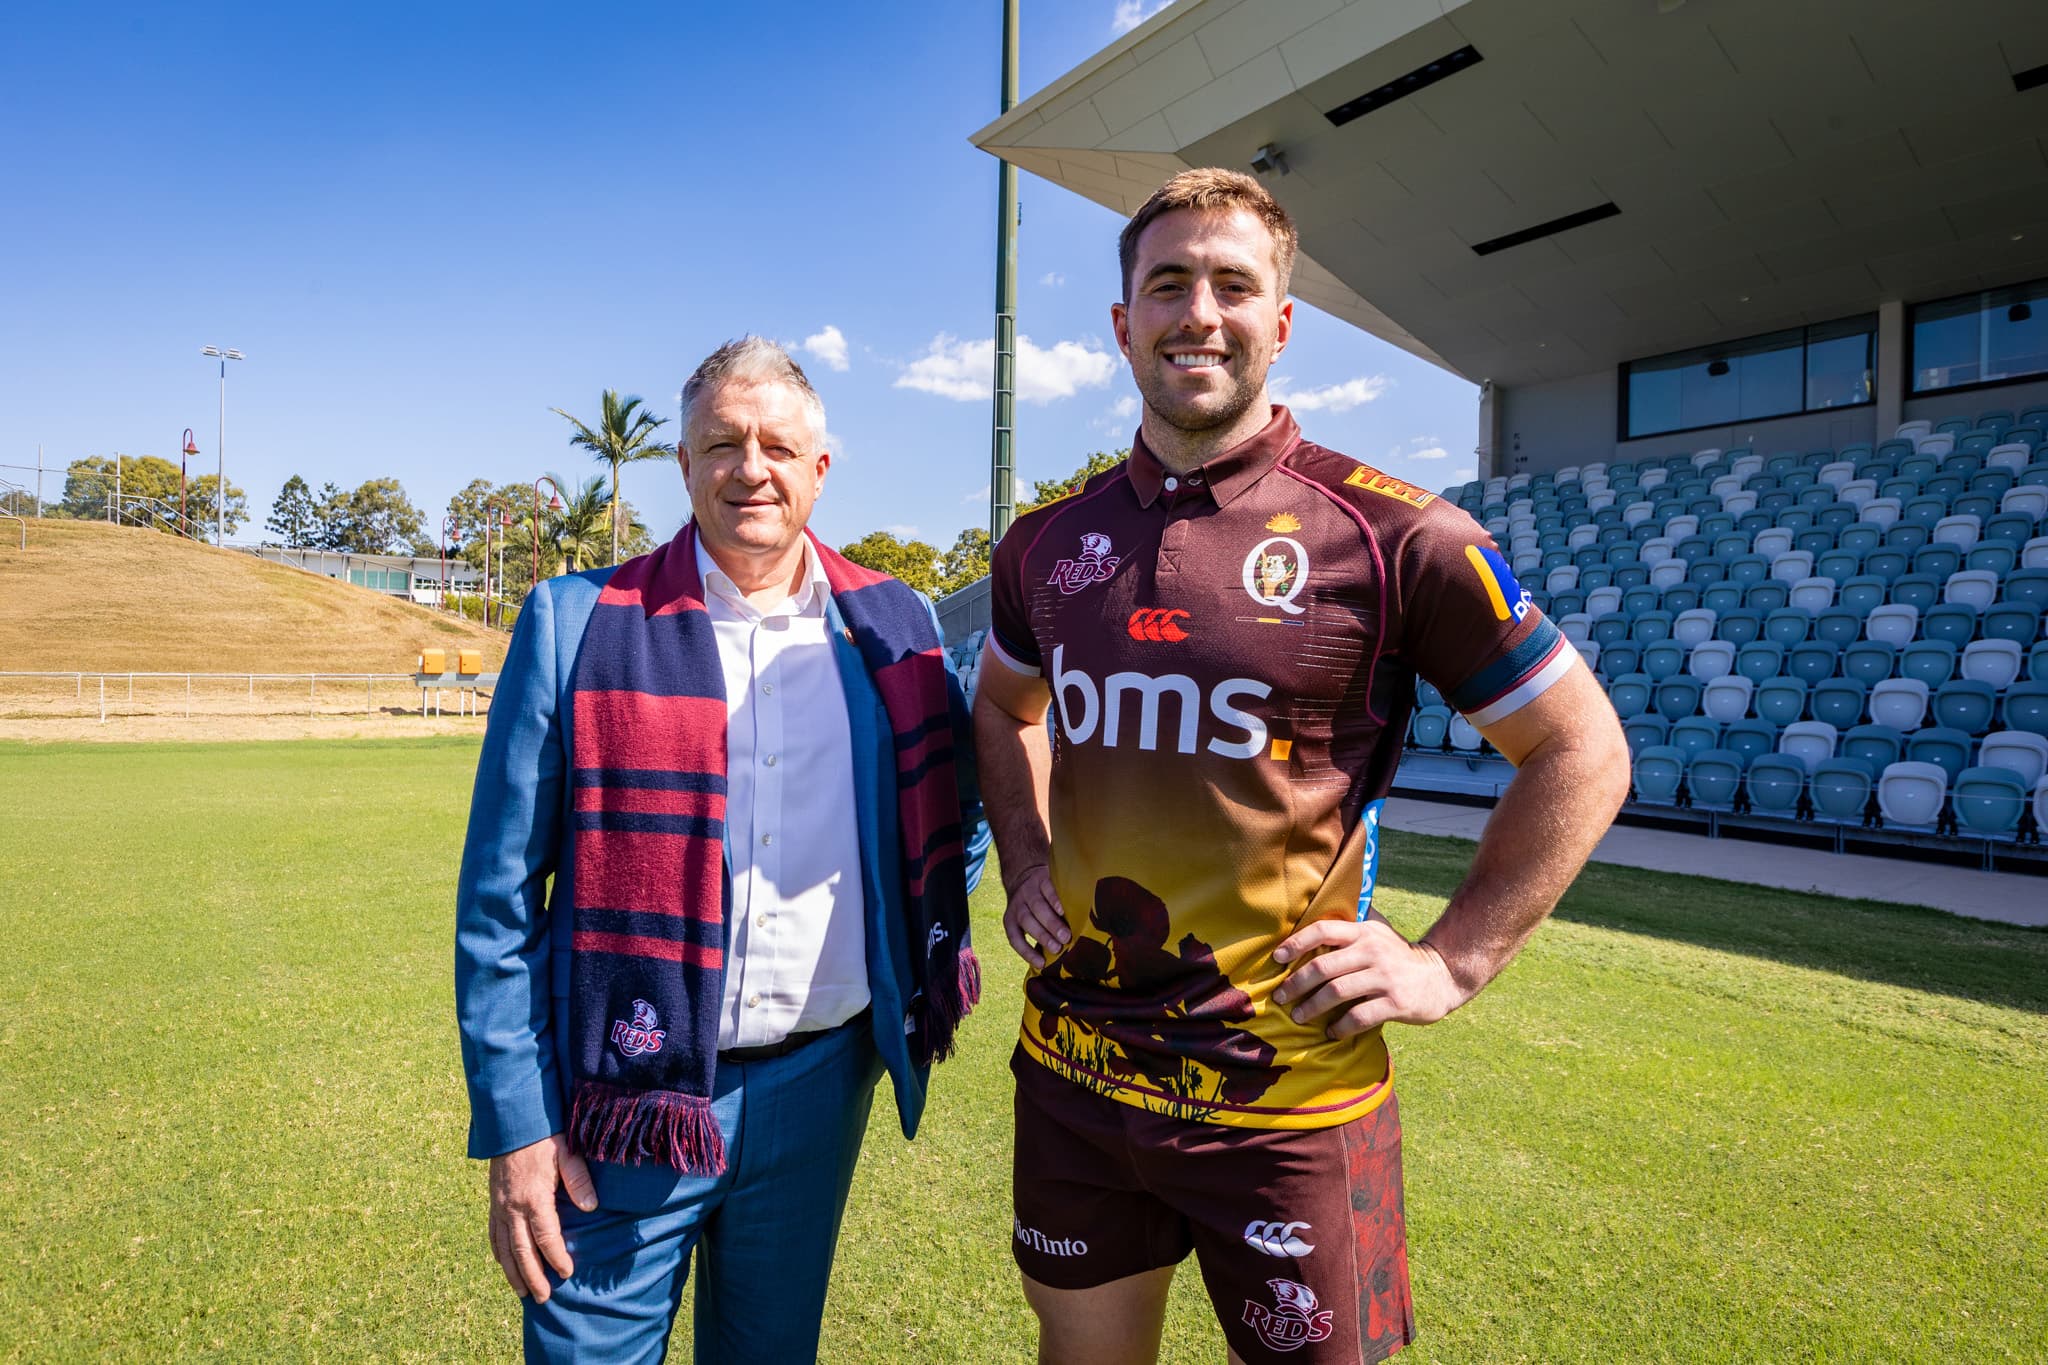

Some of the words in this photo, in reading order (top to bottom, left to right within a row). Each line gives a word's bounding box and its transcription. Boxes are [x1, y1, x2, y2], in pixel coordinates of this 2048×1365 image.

[1046, 556, 1121, 595] REDS
[1242, 536, 1310, 615] Q
[610, 1019, 667, 1057] REDS
[1241, 1299, 1334, 1352] REDS
